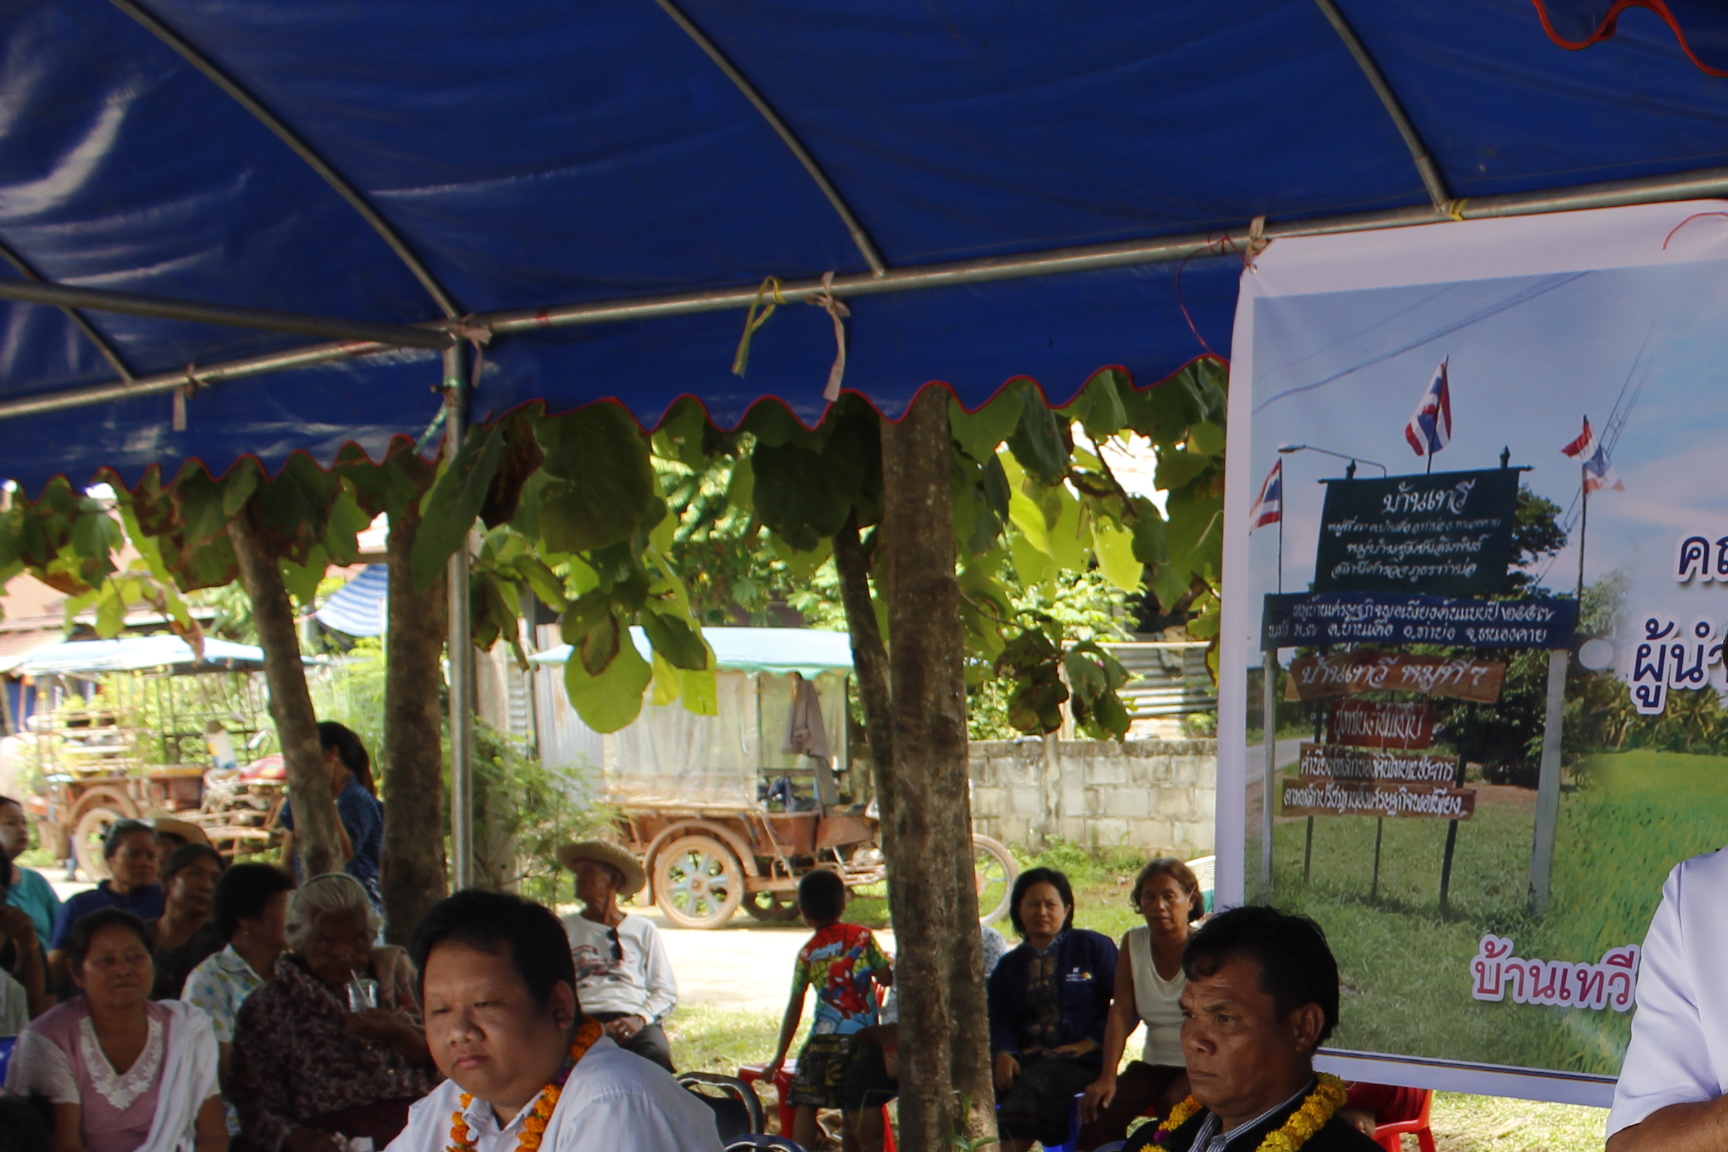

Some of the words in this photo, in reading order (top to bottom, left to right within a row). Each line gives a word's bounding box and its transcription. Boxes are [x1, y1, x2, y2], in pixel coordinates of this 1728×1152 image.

[1381, 479, 1476, 516] บ้านเทวี
[1301, 656, 1399, 688] บ้านเทวี
[1475, 941, 1635, 1005] บ้านเทวี
